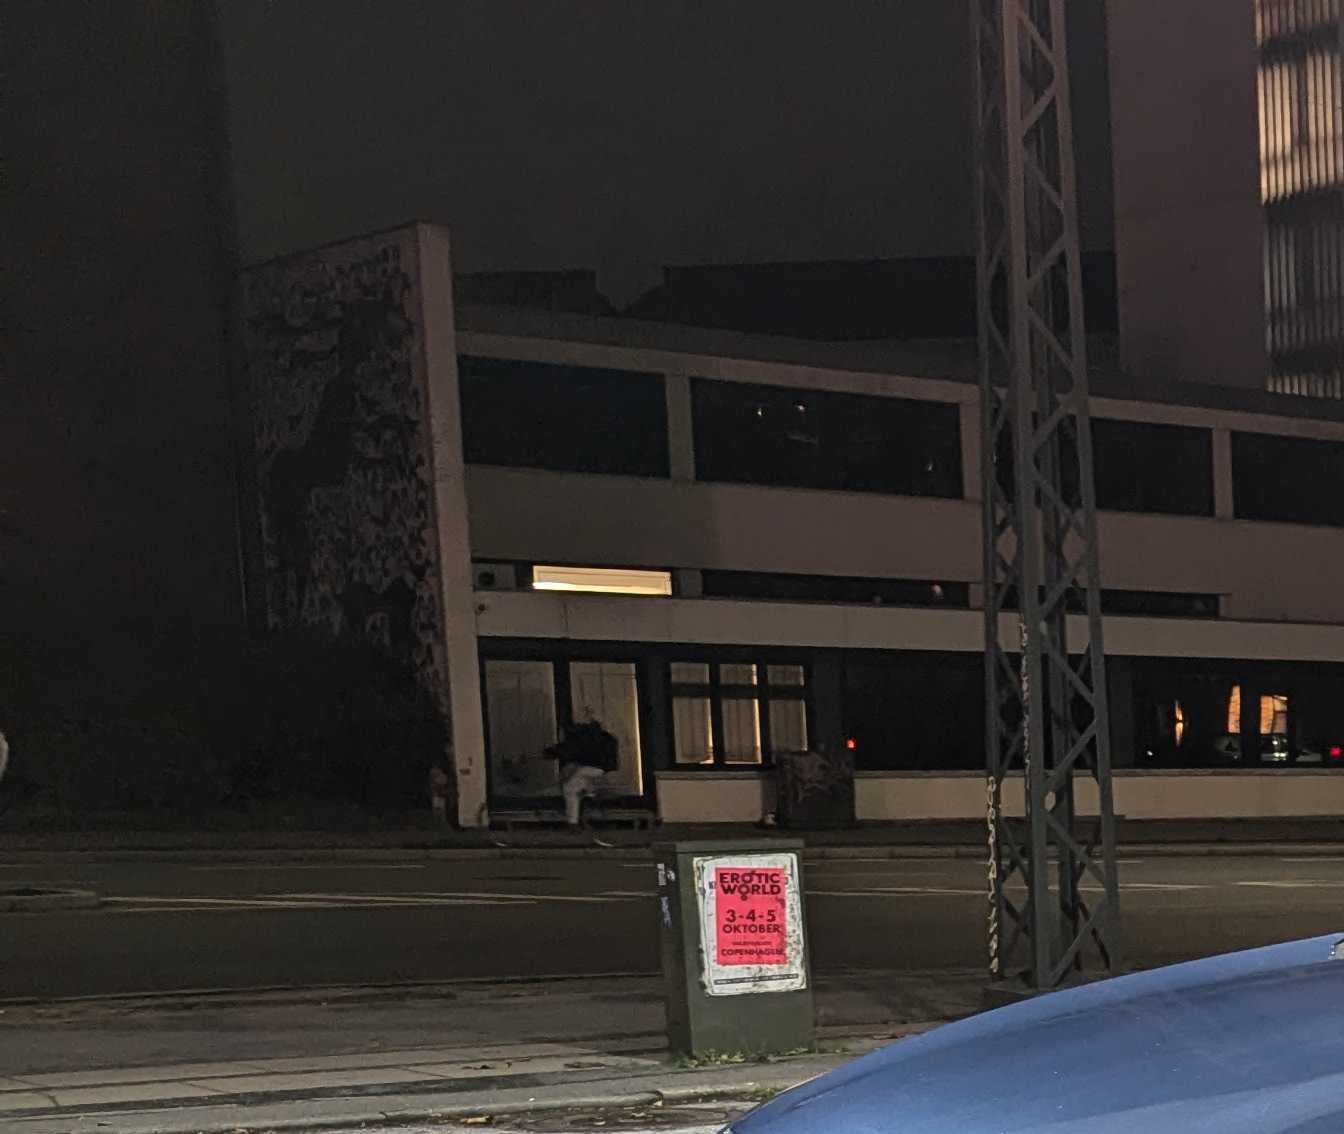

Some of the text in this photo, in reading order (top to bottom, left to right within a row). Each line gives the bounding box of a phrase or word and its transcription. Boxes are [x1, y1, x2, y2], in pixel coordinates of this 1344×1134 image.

[720, 871, 780, 884] EROTIC
[721, 884, 781, 901] WORLD
[722, 924, 780, 934] OKTOBER
